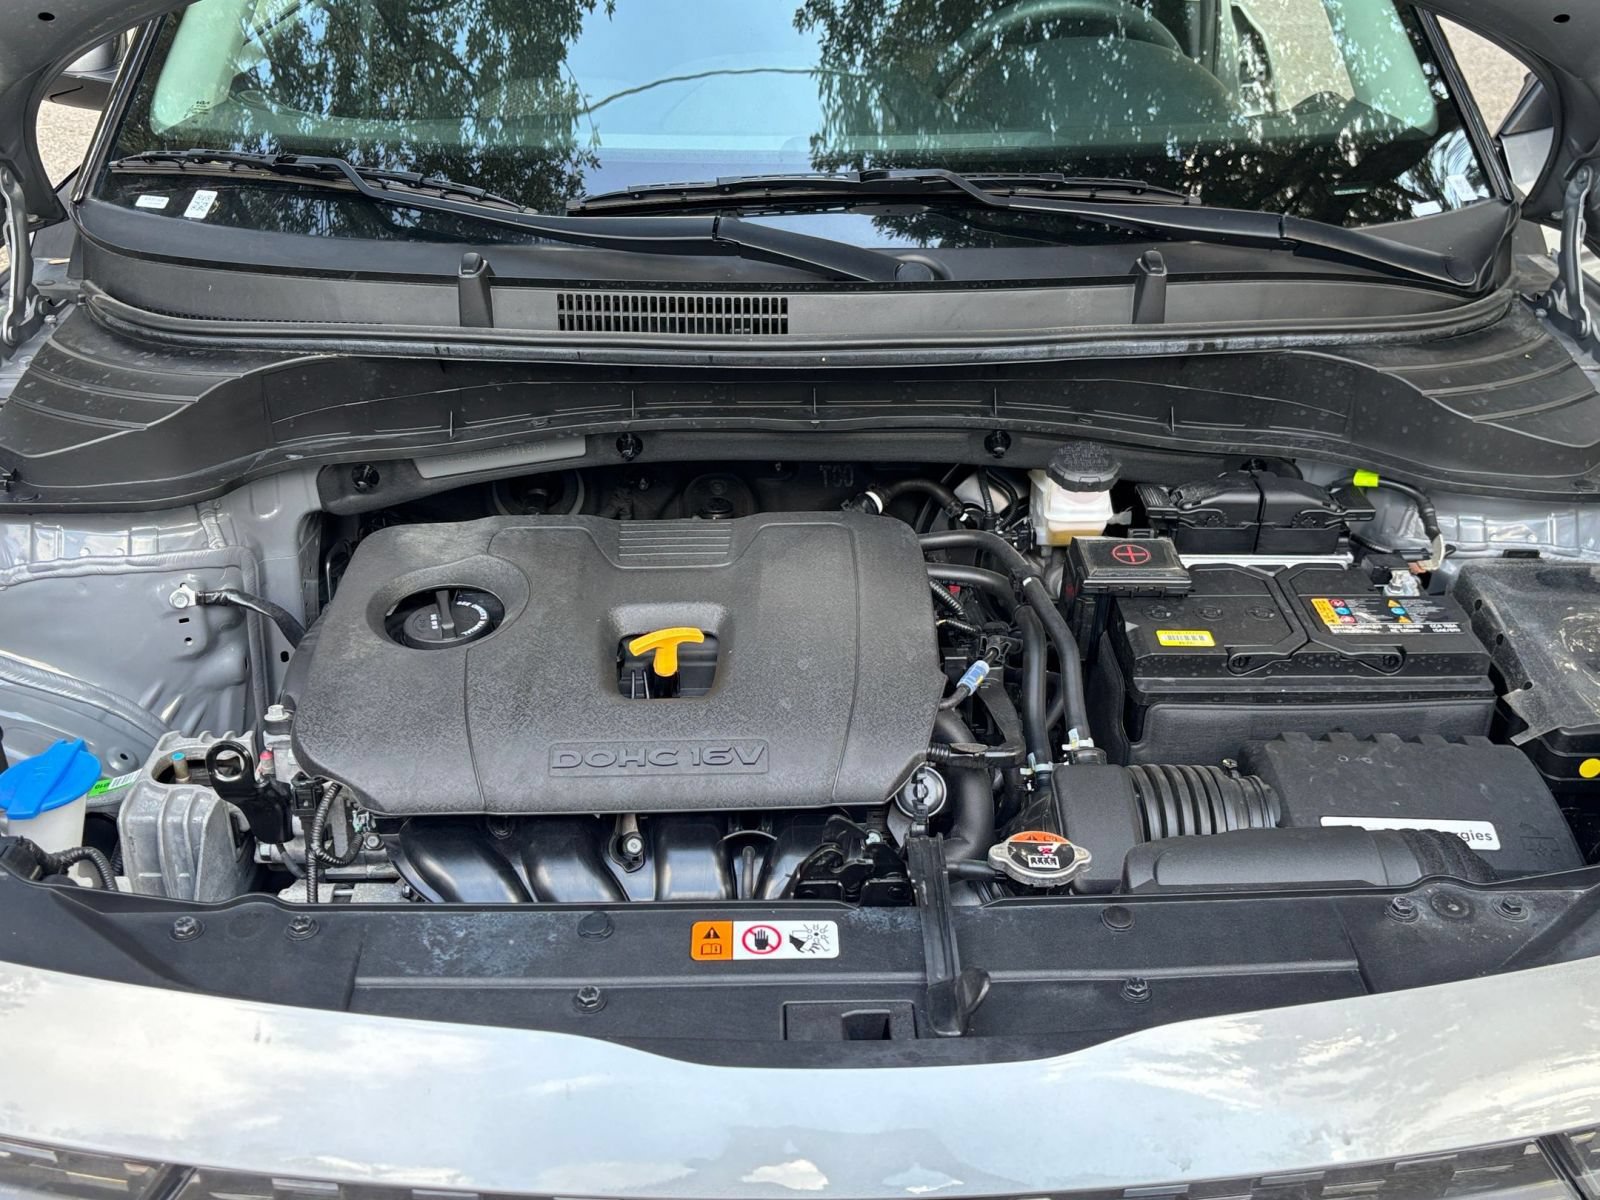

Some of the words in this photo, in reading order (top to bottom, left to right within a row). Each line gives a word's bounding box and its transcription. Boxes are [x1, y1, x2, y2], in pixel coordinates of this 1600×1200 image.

[551, 748, 680, 769] DOHC
[690, 746, 765, 766] 16V
[1457, 829, 1493, 842] gies
